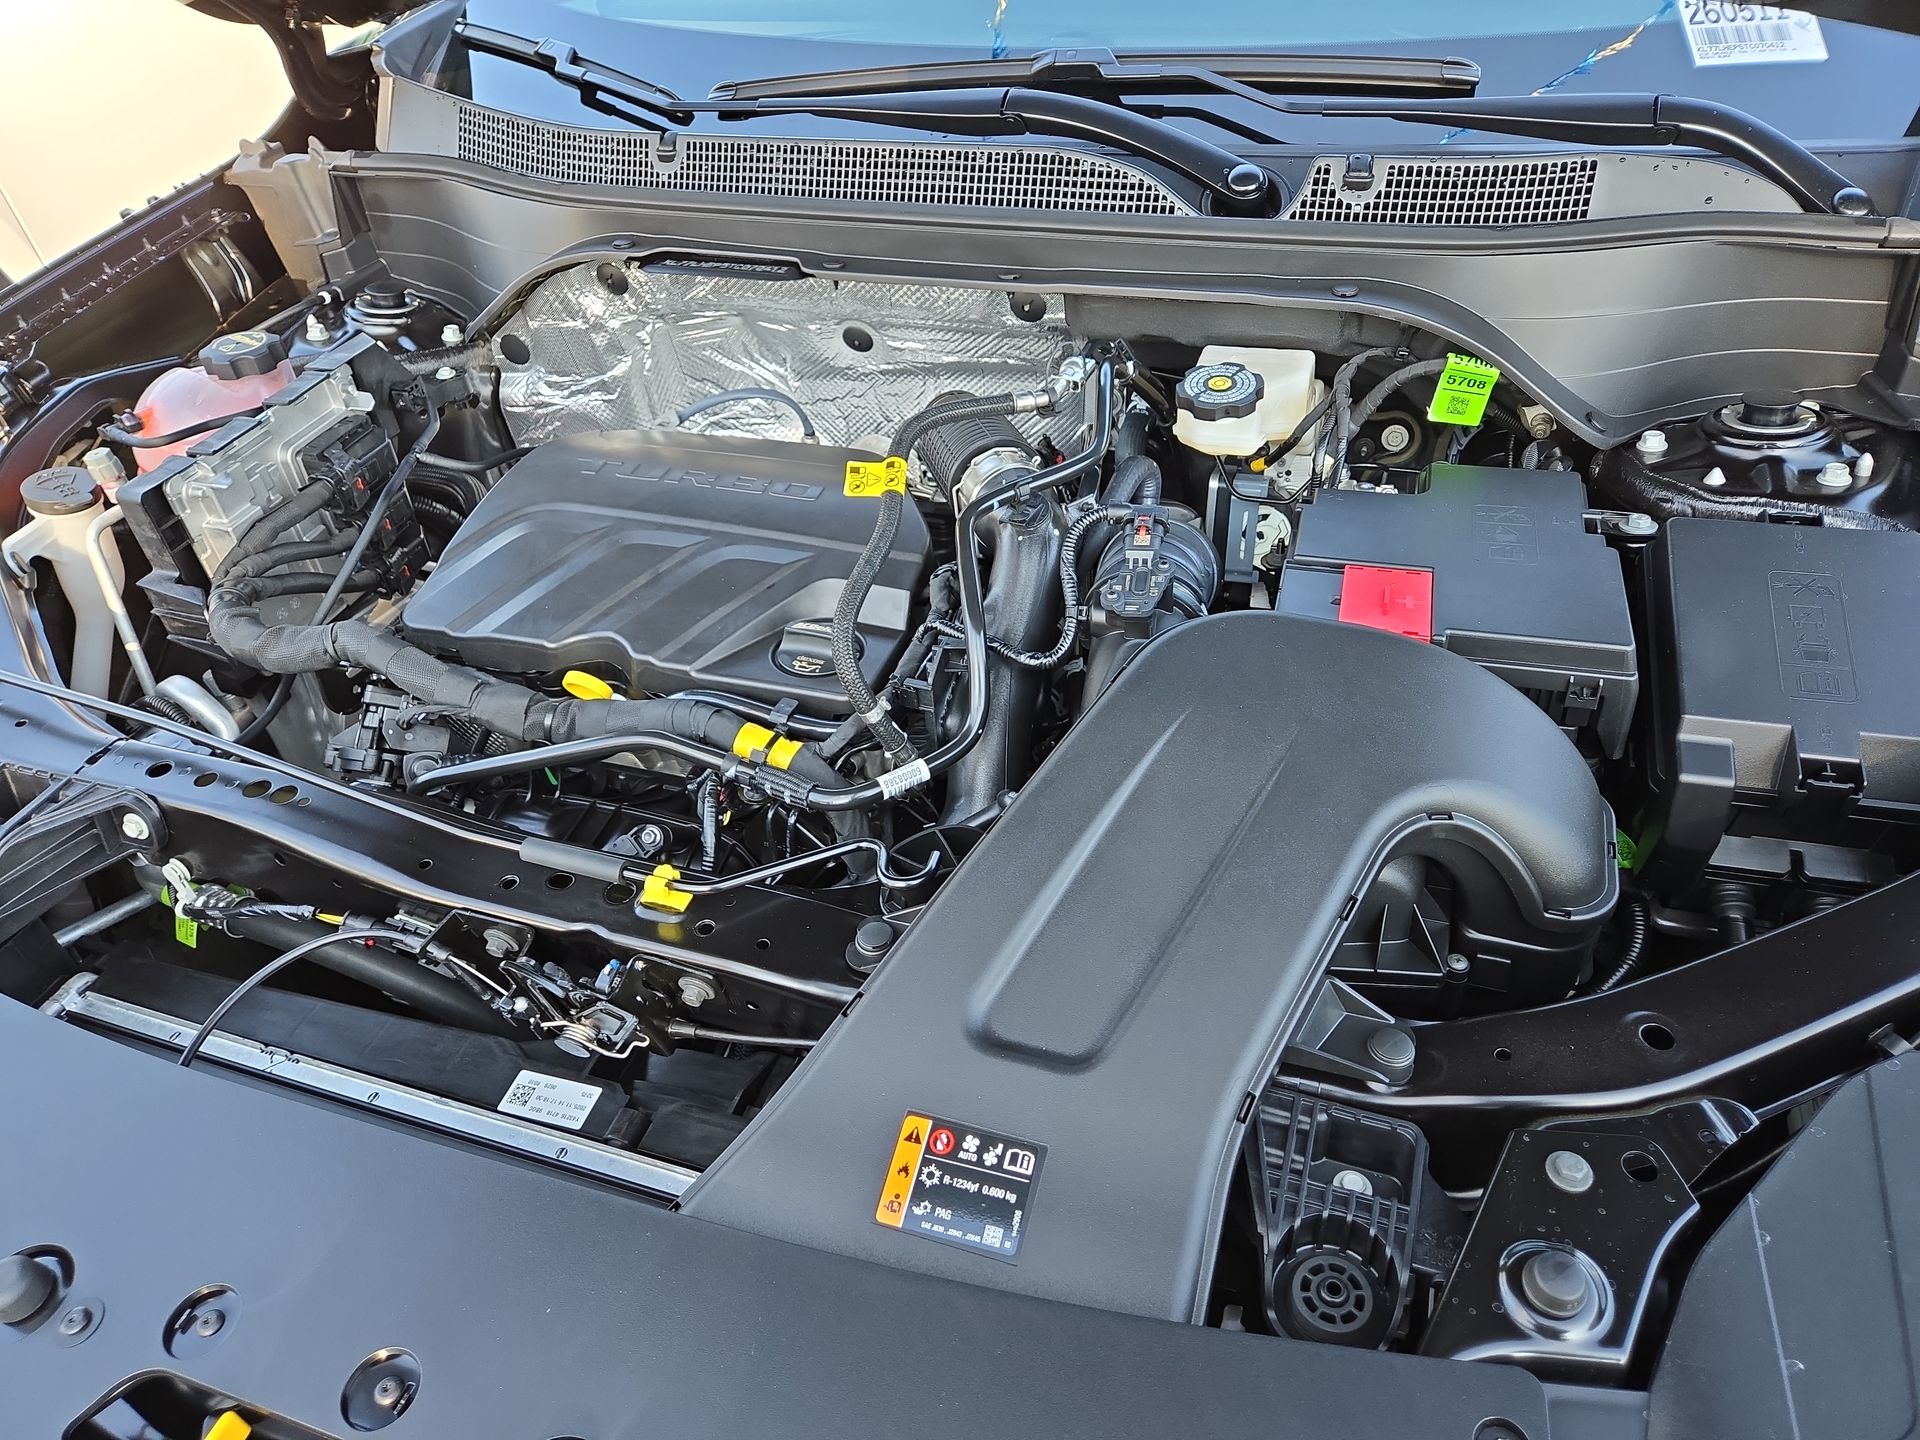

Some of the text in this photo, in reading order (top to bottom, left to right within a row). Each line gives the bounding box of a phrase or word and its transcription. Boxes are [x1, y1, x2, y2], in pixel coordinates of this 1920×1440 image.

[1446, 374, 1487, 389] 5708
[577, 458, 826, 501] TURBO
[958, 1150, 978, 1162] AUTO
[942, 1175, 1017, 1204] R-1234yf 0.600 kg
[934, 1206, 952, 1220] PAG
